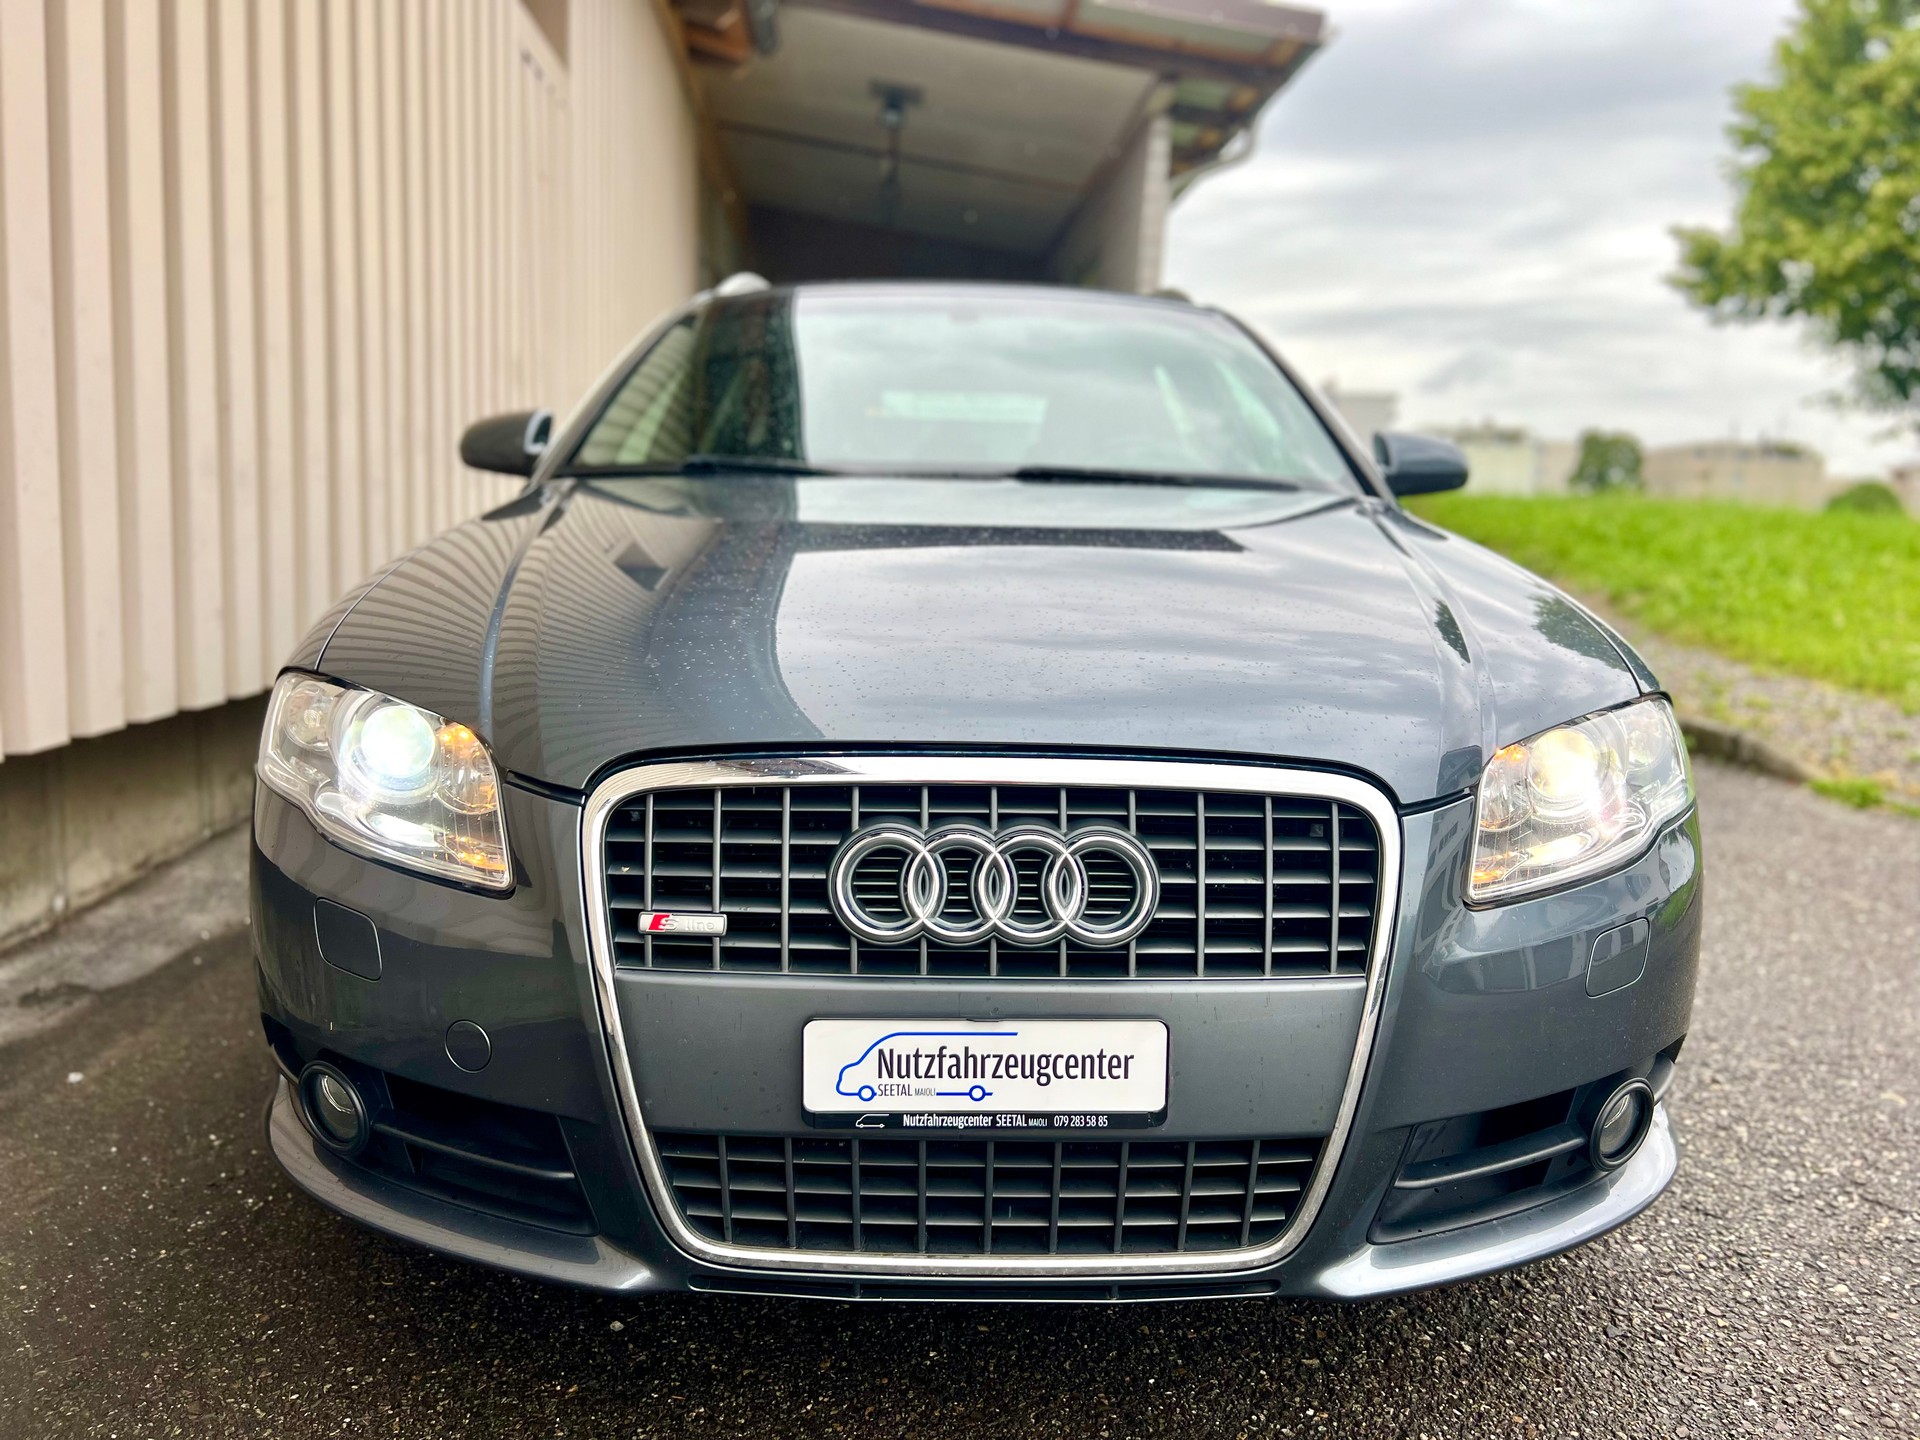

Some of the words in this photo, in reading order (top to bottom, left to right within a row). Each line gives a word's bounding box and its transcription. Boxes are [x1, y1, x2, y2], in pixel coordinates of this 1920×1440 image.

[684, 918, 715, 932] line
[877, 1045, 1135, 1087] Nutzfahrzeugcenter
[877, 1083, 913, 1097] SEETAL
[914, 1087, 936, 1097] MAIOLI
[902, 1113, 994, 1129] Nutzfahrzeugcenter
[995, 1114, 1028, 1127] SEETAL
[1028, 1118, 1048, 1127] MAIOLI
[1053, 1115, 1070, 1127] 079
[1070, 1115, 1085, 1127] 283
[1086, 1115, 1097, 1127] 58
[1097, 1115, 1108, 1127] 85
